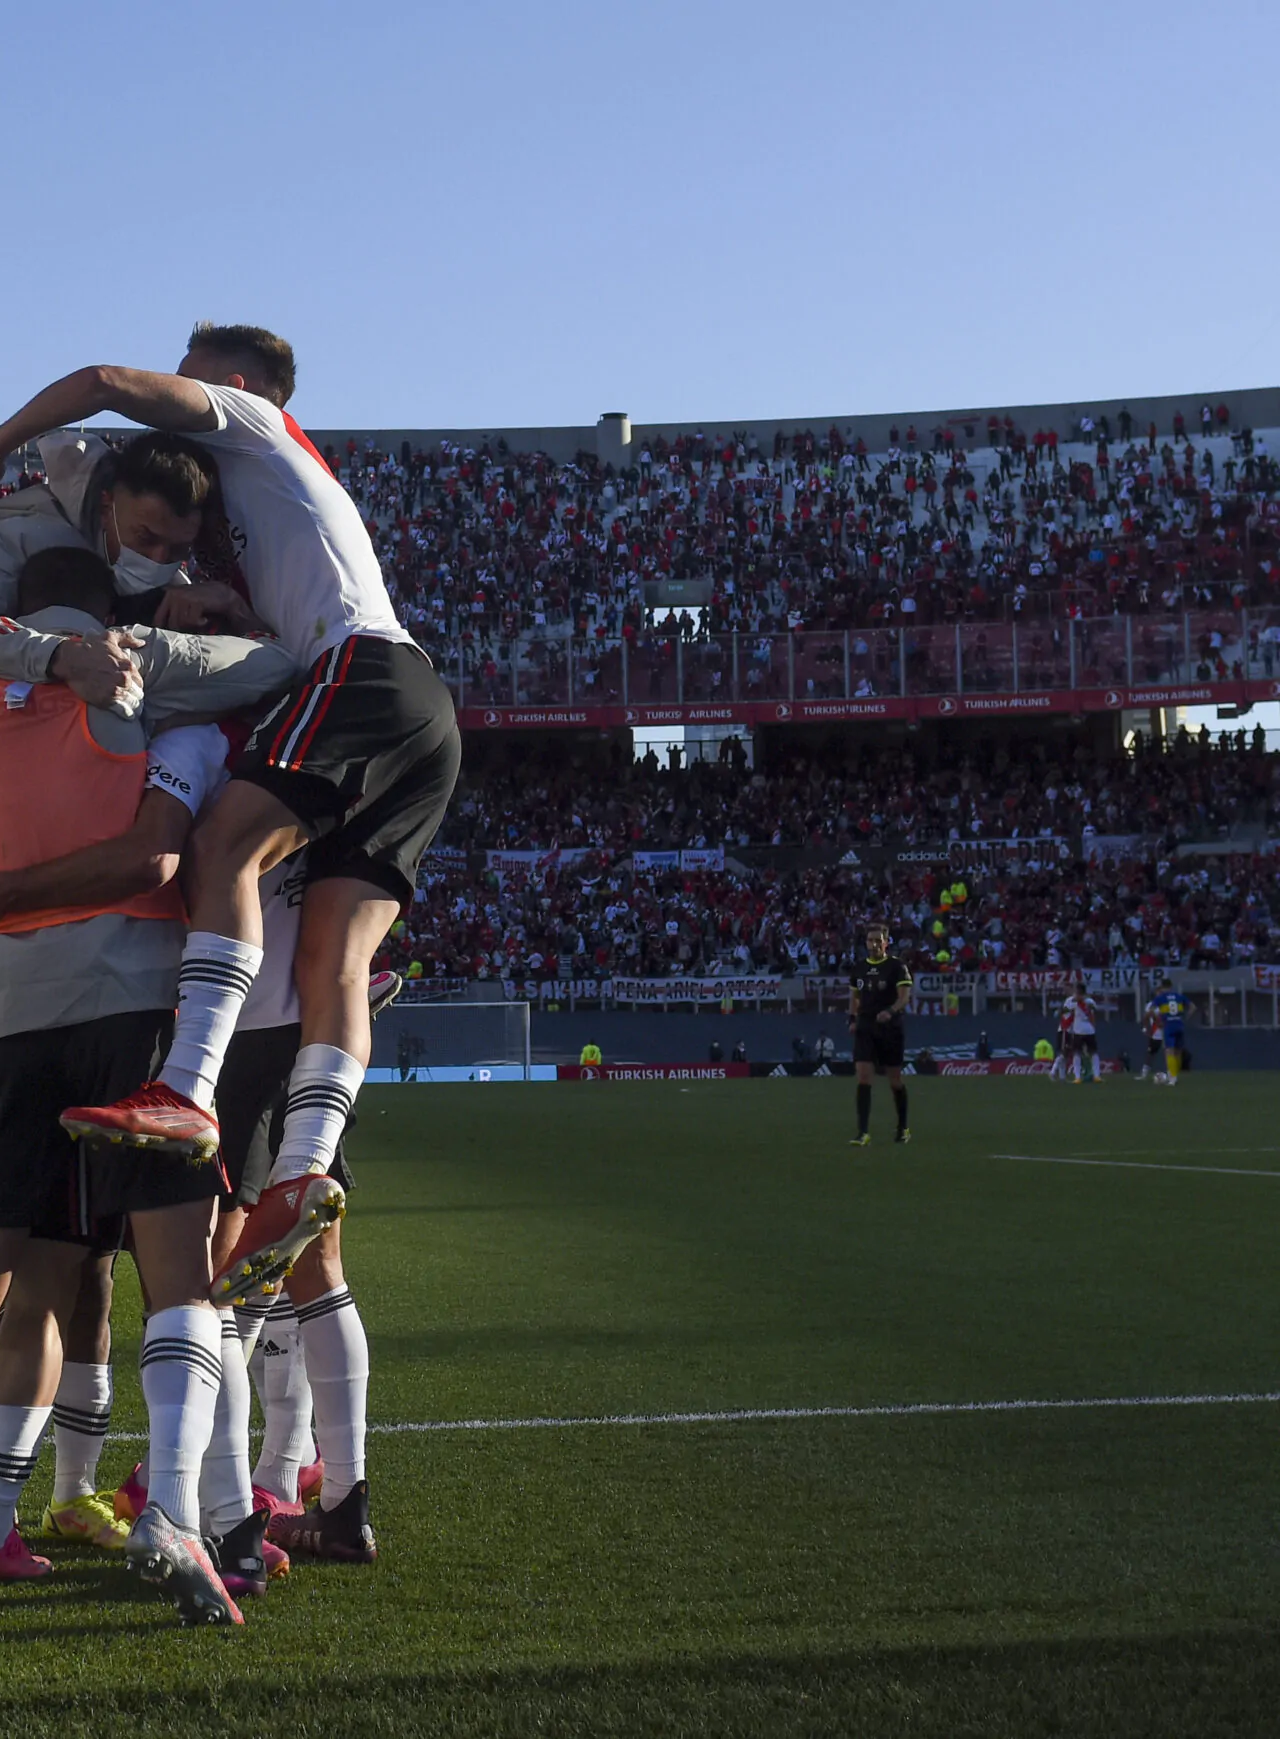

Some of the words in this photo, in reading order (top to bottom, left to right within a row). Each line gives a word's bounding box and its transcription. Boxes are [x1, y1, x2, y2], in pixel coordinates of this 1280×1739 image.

[964, 699, 1008, 709] TURKISH
[645, 711, 683, 720] TURKIS
[689, 709, 733, 718] AIRLINES
[997, 971, 1077, 990] CERVEZA
[1101, 969, 1165, 988] RIVER
[665, 980, 707, 999] ARIEL
[713, 981, 777, 997] ORTEGA
[479, 1070, 492, 1081] R
[607, 1070, 665, 1081] TURKISH
[669, 1068, 726, 1080] AIRLINES
